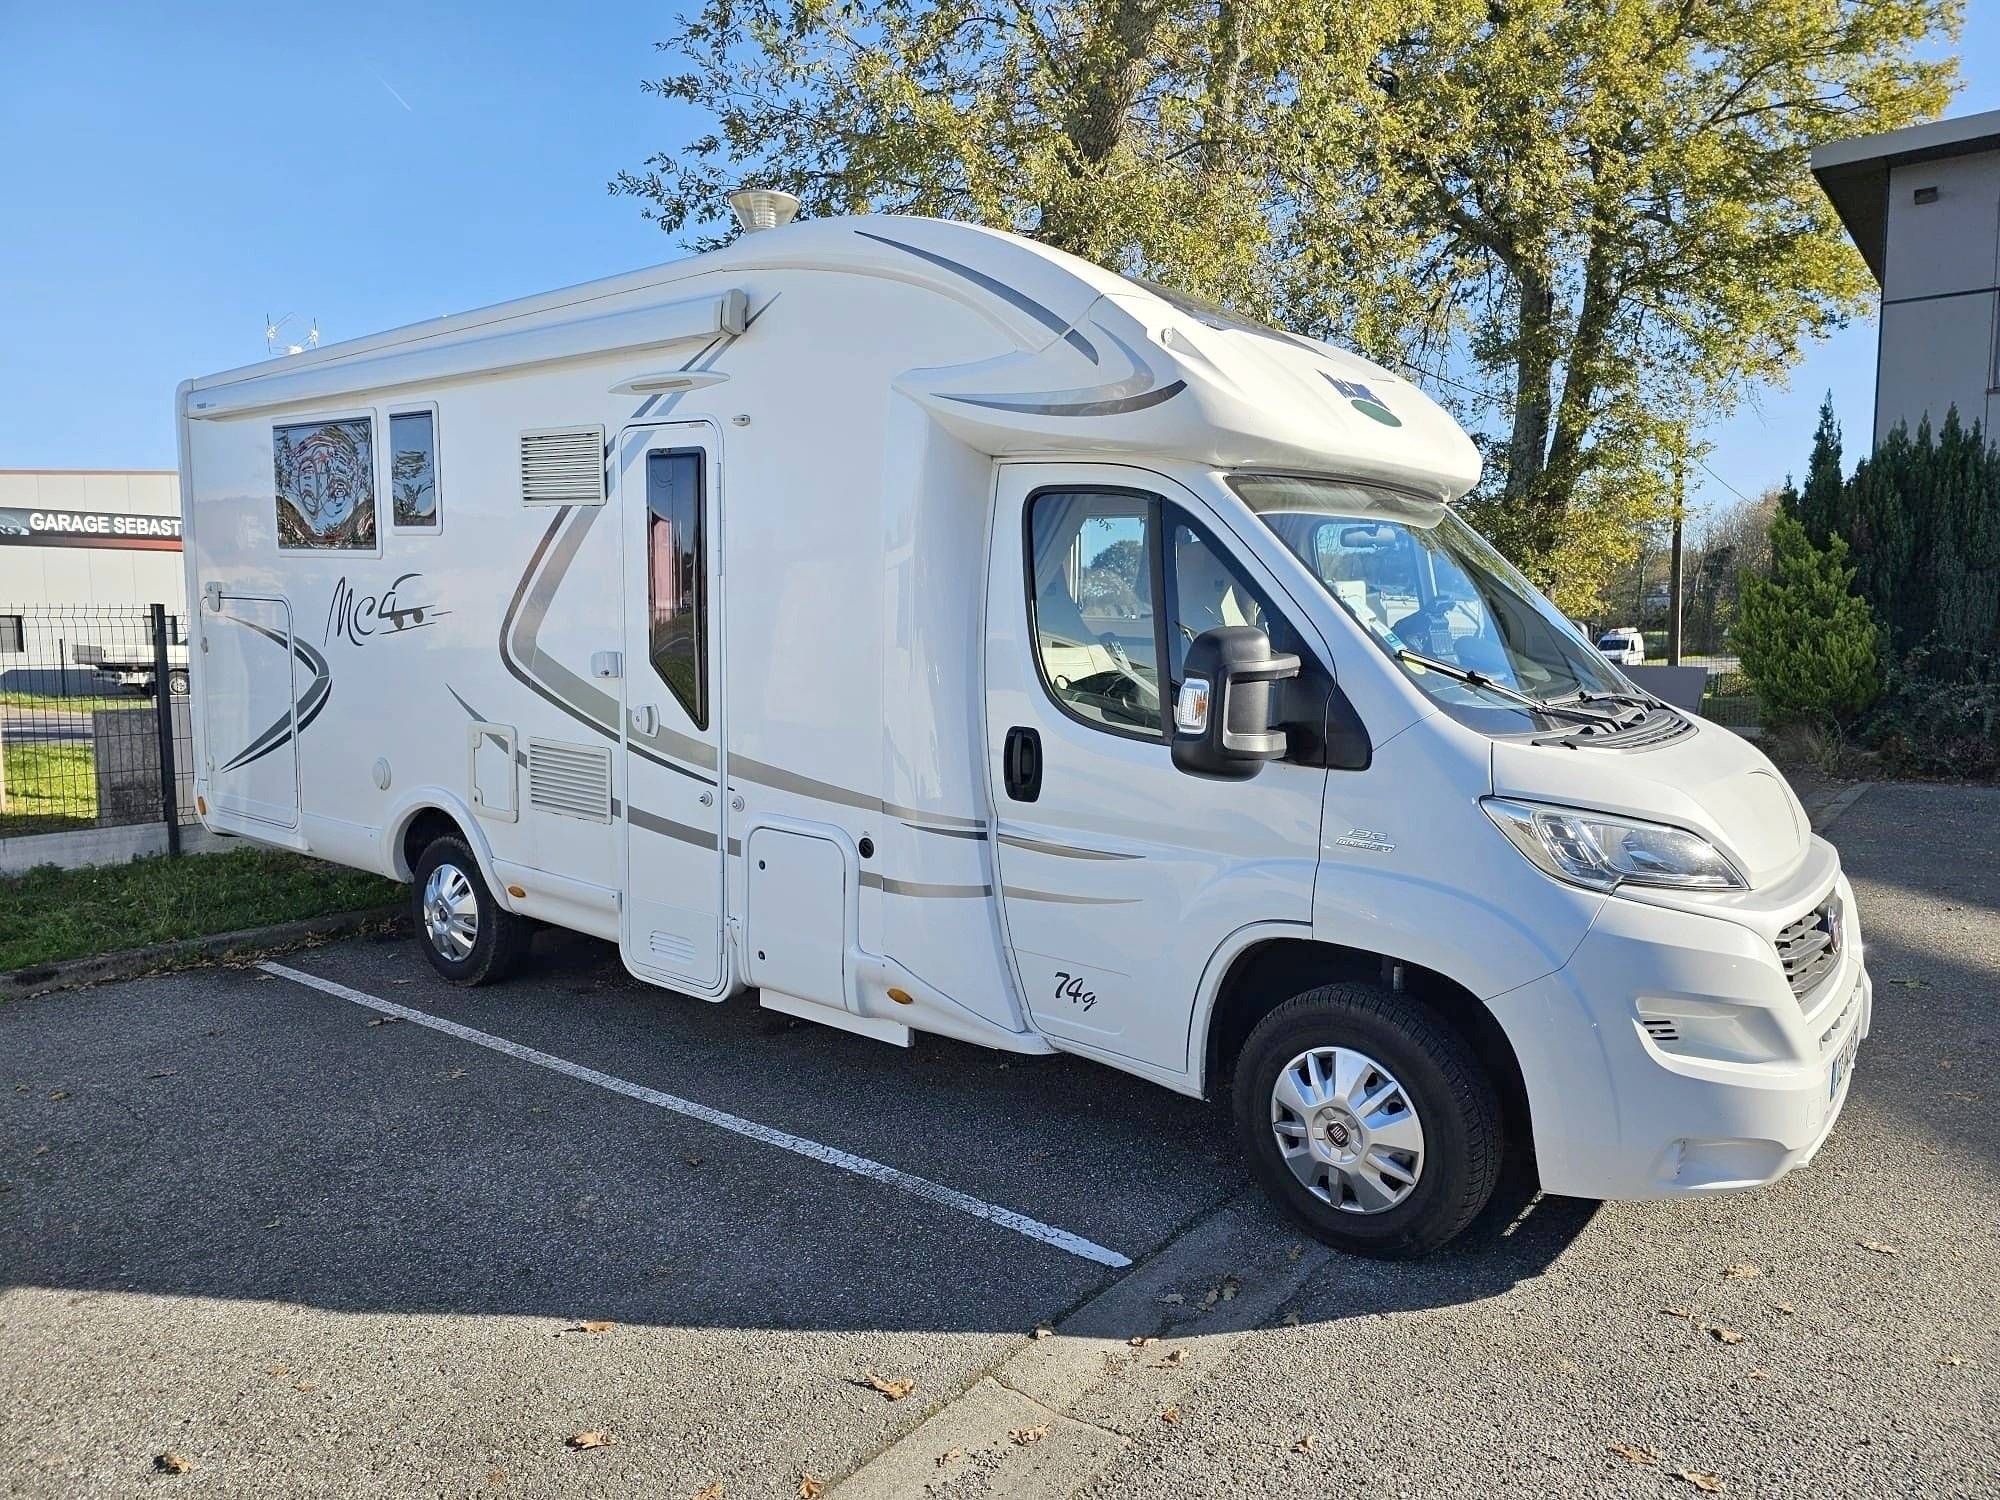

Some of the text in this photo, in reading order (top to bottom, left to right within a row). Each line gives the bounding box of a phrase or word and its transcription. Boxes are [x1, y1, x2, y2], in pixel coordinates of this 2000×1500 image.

[29, 512, 182, 537] GARAGE SEBAST
[1055, 971, 1098, 1012] 74g
